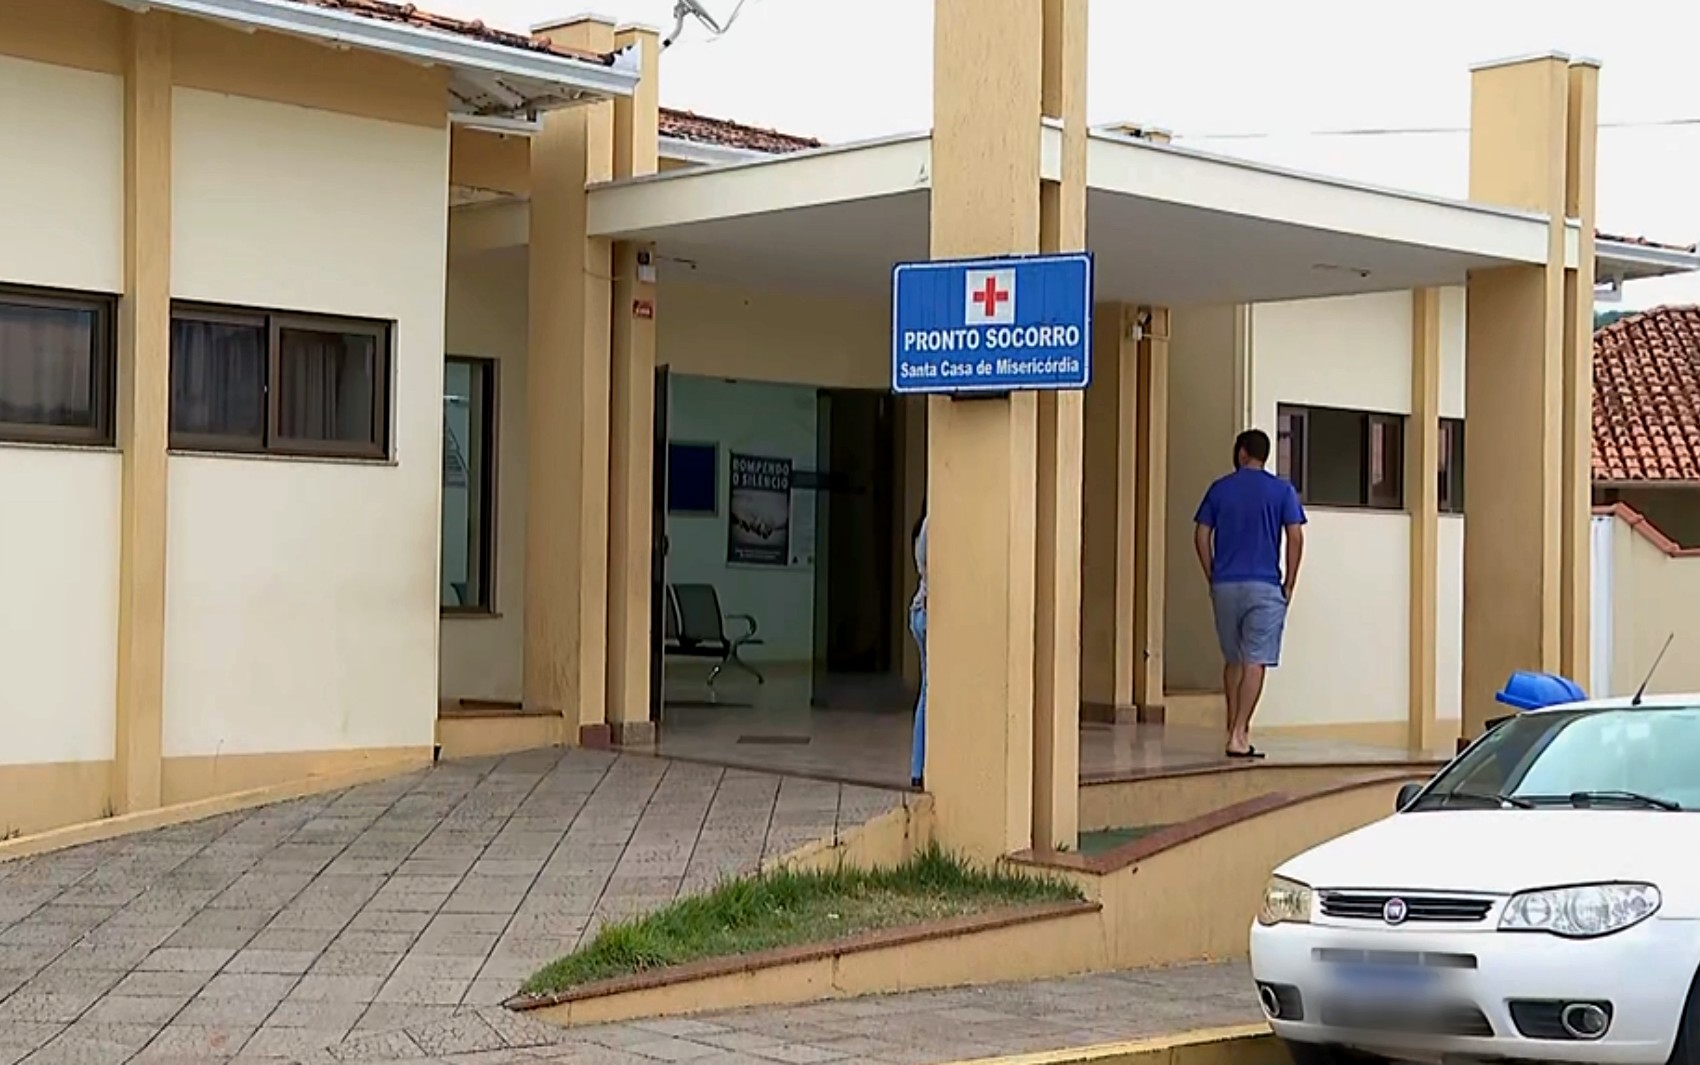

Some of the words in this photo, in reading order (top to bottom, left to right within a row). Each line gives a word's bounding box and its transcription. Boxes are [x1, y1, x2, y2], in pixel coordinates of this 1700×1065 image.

[904, 329, 980, 351] PRONTO
[985, 325, 1080, 349] SOCORRO
[900, 362, 937, 378] Santa
[940, 360, 972, 376] Casa
[976, 360, 992, 376] de
[996, 356, 1080, 375] Misericórdia
[732, 457, 790, 476] ROMPENDO
[732, 472, 739, 486] O
